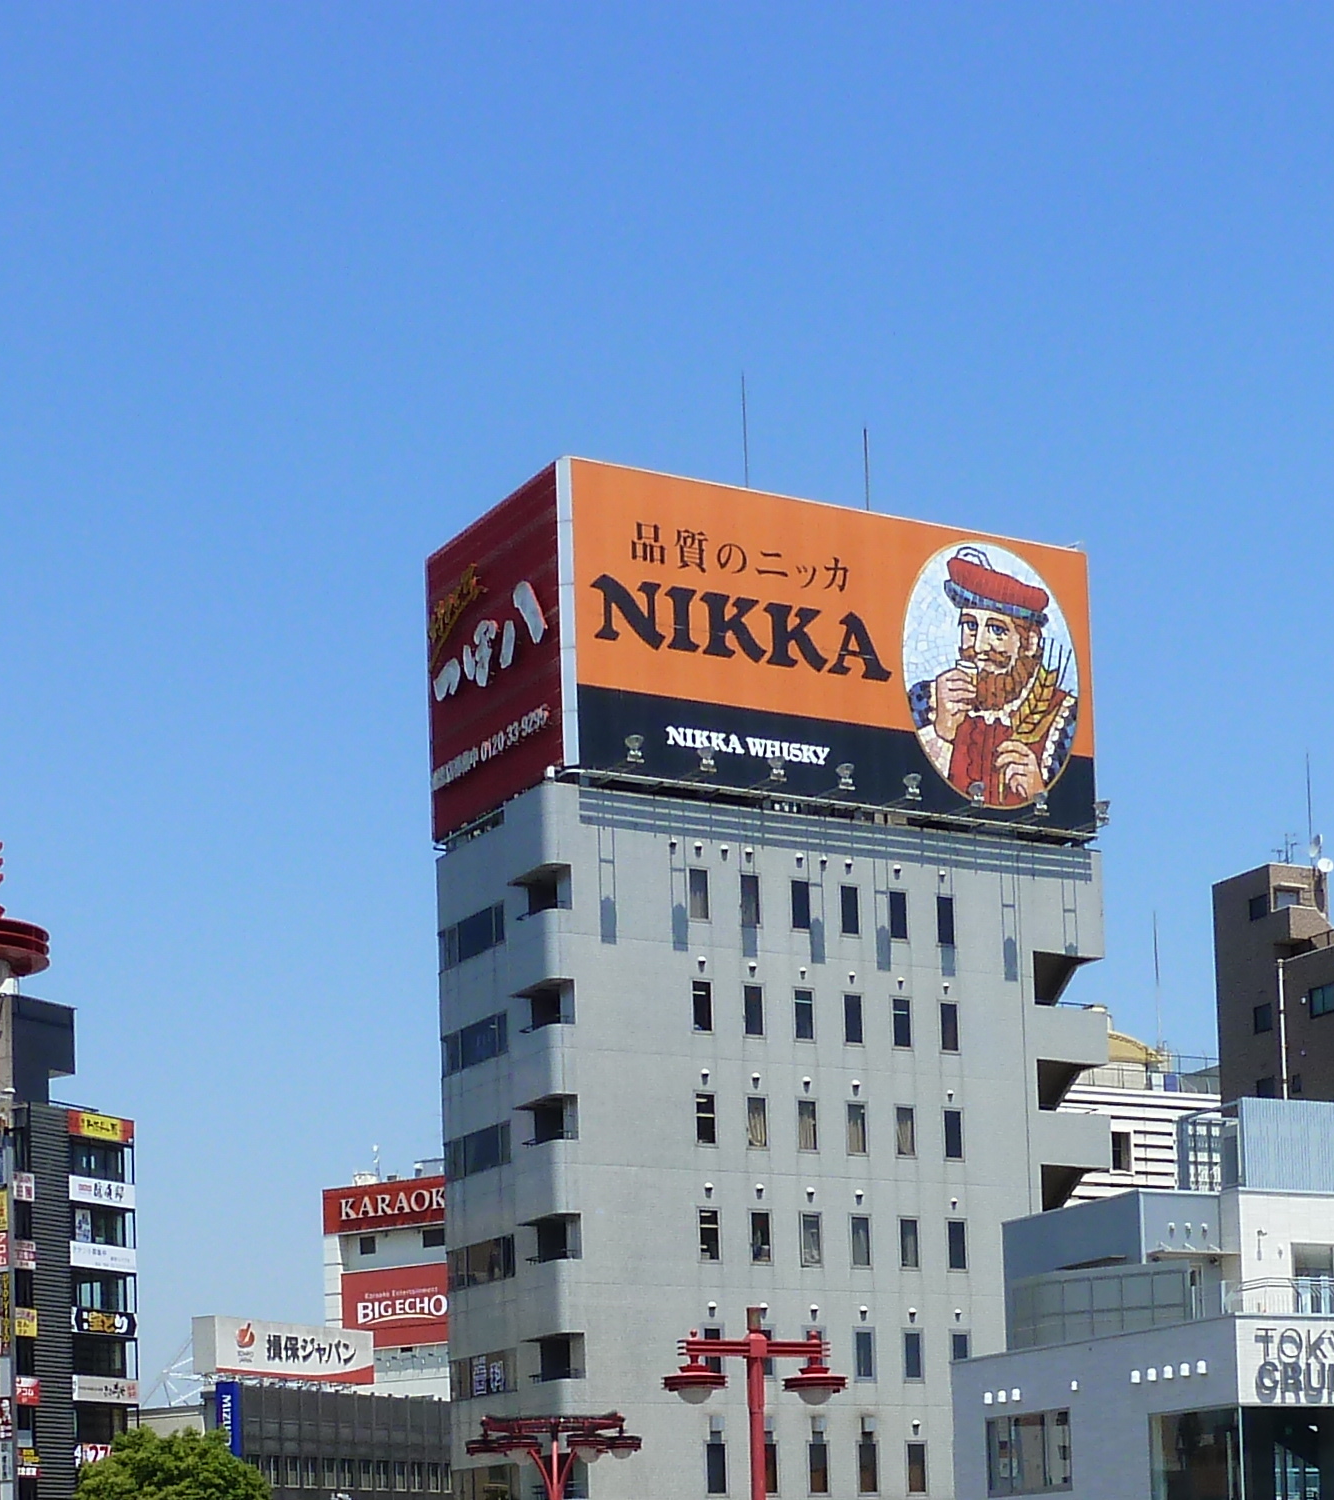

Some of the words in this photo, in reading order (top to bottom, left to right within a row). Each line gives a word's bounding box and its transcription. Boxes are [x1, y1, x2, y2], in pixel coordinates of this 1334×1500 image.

[629, 521, 850, 593] 品質のニッカ
[590, 572, 892, 682] NIKKA
[666, 725, 744, 757] NIKKA
[746, 737, 830, 767] WHISKY
[357, 1299, 392, 1324] BIG
[395, 1294, 448, 1317] ECHO
[266, 1334, 357, 1365] 損保ジャパン
